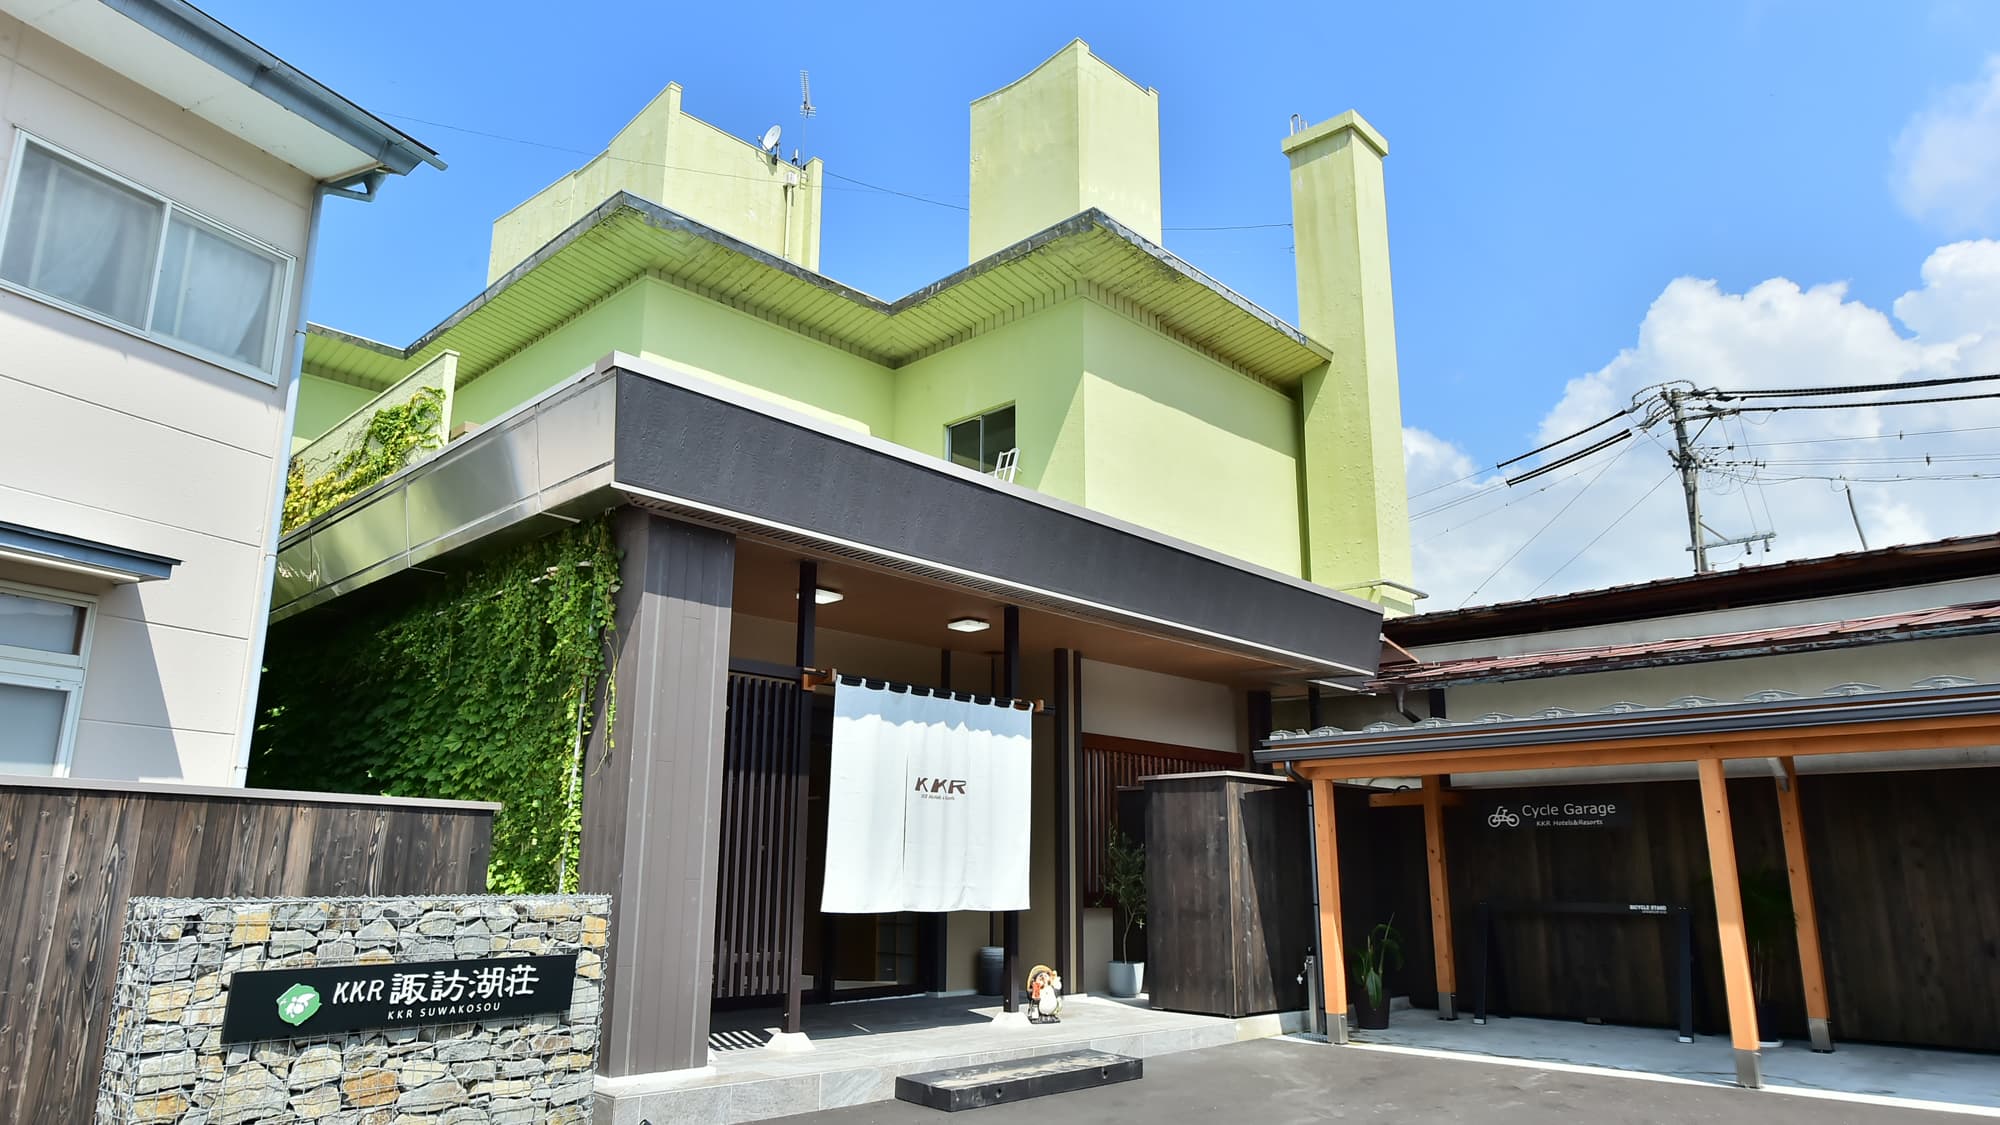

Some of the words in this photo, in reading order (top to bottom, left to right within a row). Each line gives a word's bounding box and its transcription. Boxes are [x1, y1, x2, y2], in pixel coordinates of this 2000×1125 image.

[915, 777, 967, 794] KKR
[1522, 804, 1559, 818] Cycle
[1563, 803, 1616, 816] Garage
[332, 979, 383, 1005] KKR
[389, 964, 540, 1005] 諏訪湖荘
[387, 1008, 413, 1020] KKR
[419, 1003, 501, 1018] SUWAKOSOU
